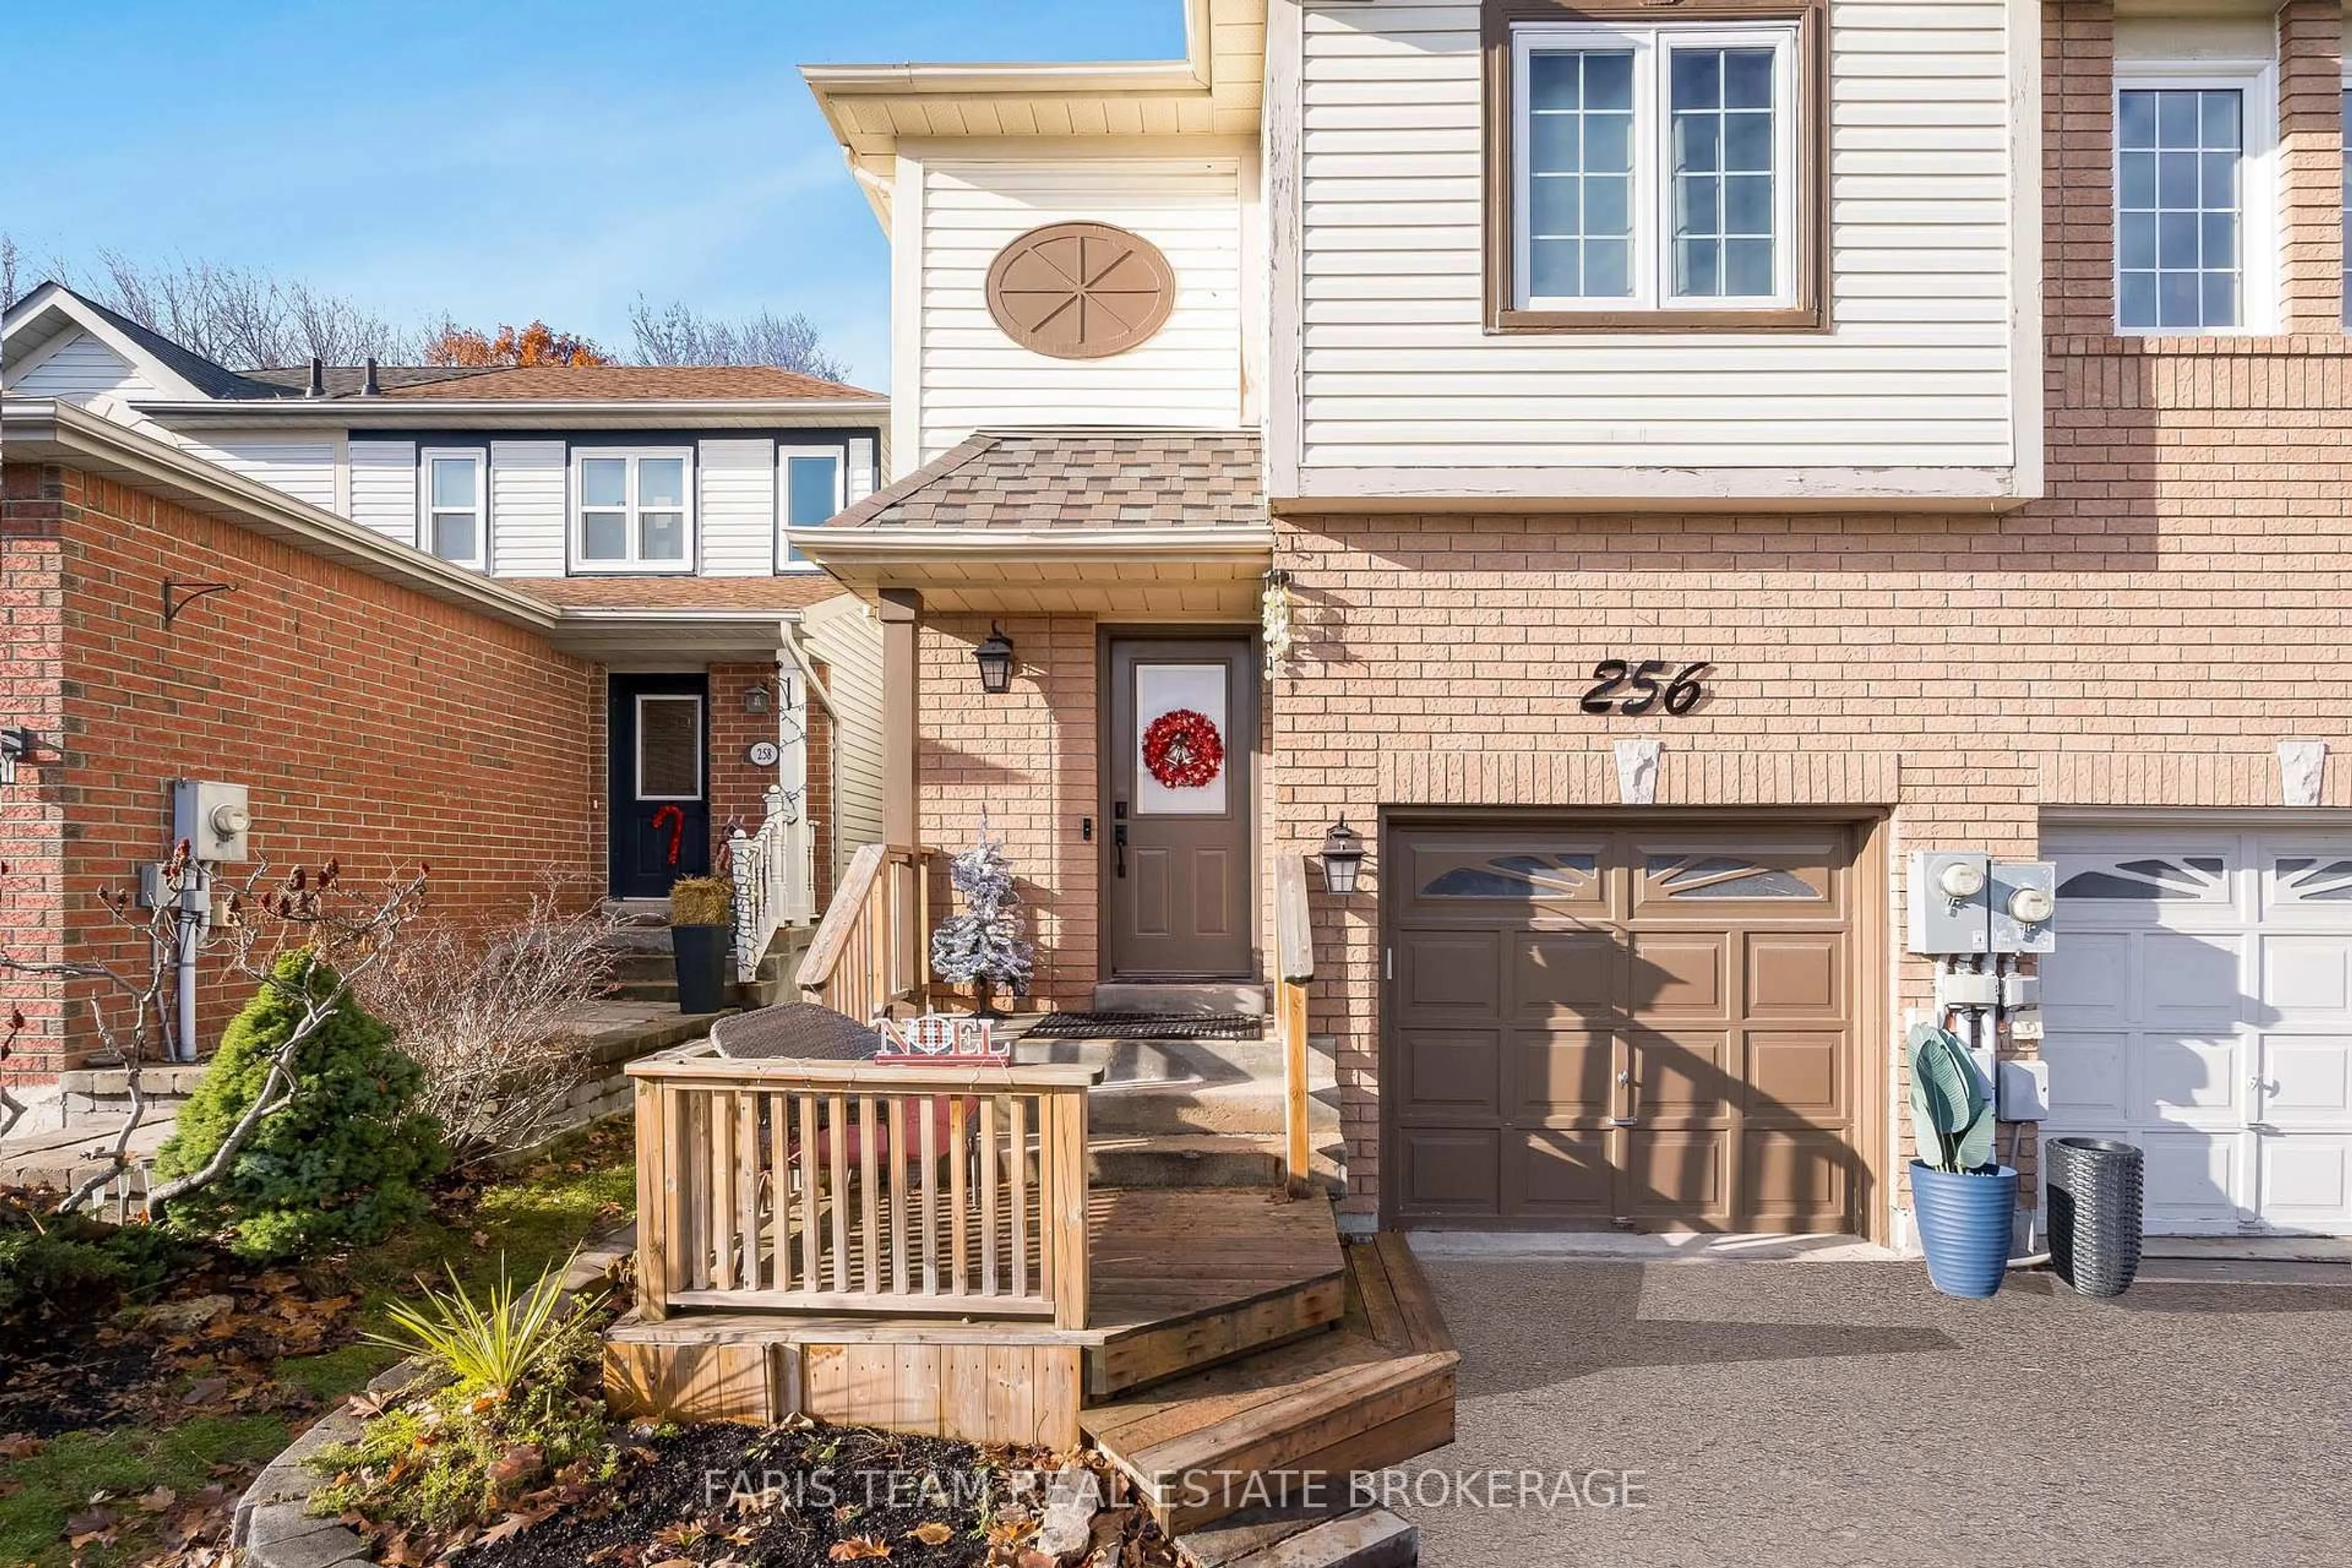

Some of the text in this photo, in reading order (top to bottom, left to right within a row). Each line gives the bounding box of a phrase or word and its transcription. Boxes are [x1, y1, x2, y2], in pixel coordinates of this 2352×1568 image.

[1580, 659, 1709, 716] 256
[757, 748, 772, 760] 258
[876, 1013, 1011, 1056] NOEL
